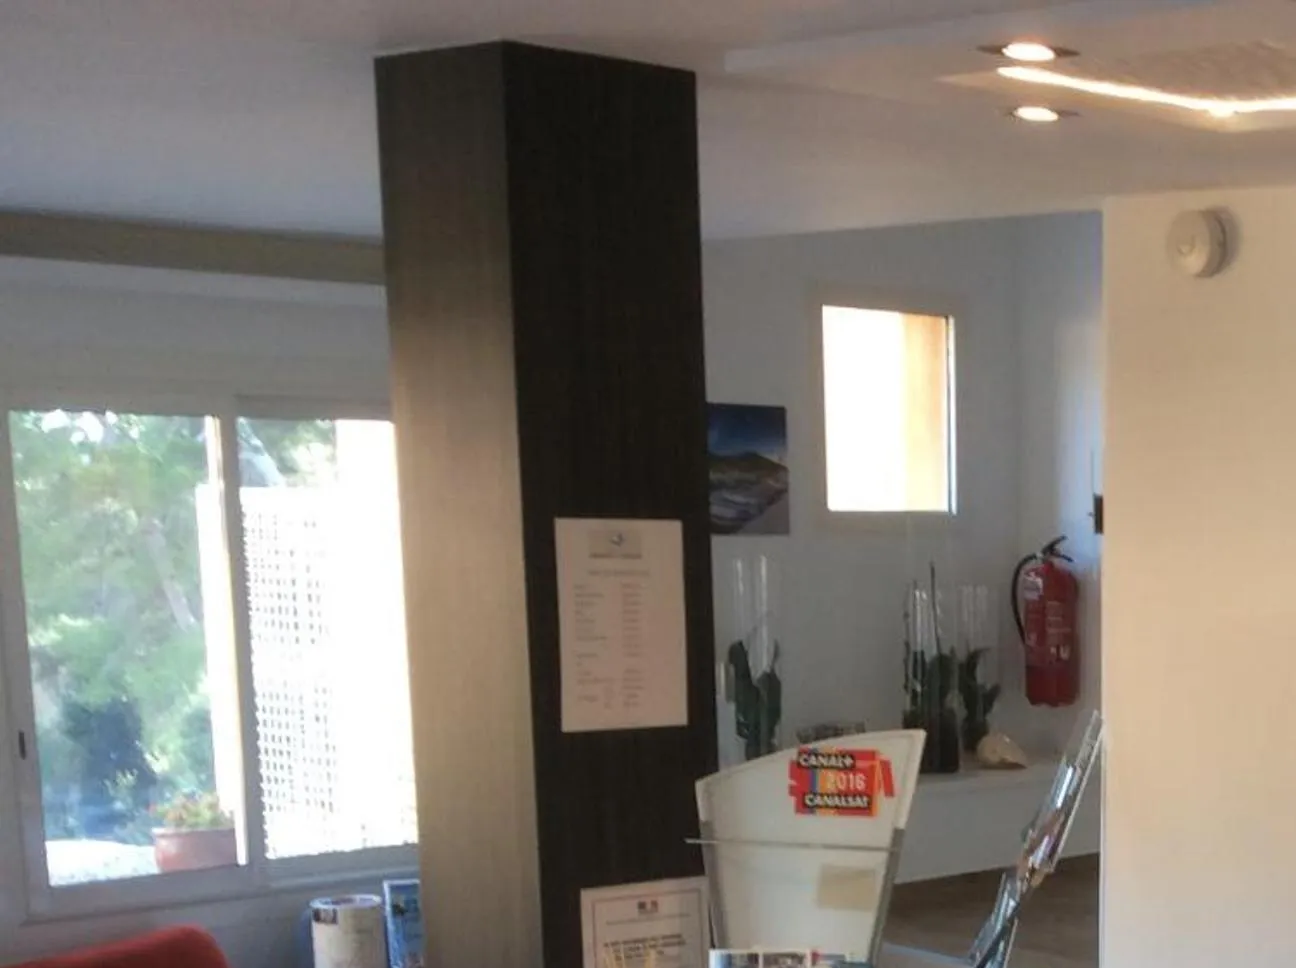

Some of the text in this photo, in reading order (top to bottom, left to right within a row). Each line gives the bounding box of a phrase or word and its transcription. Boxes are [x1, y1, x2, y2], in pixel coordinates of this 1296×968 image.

[799, 753, 854, 768] CANAL+
[825, 771, 866, 791] 2016
[804, 793, 869, 808] CANALSAT
